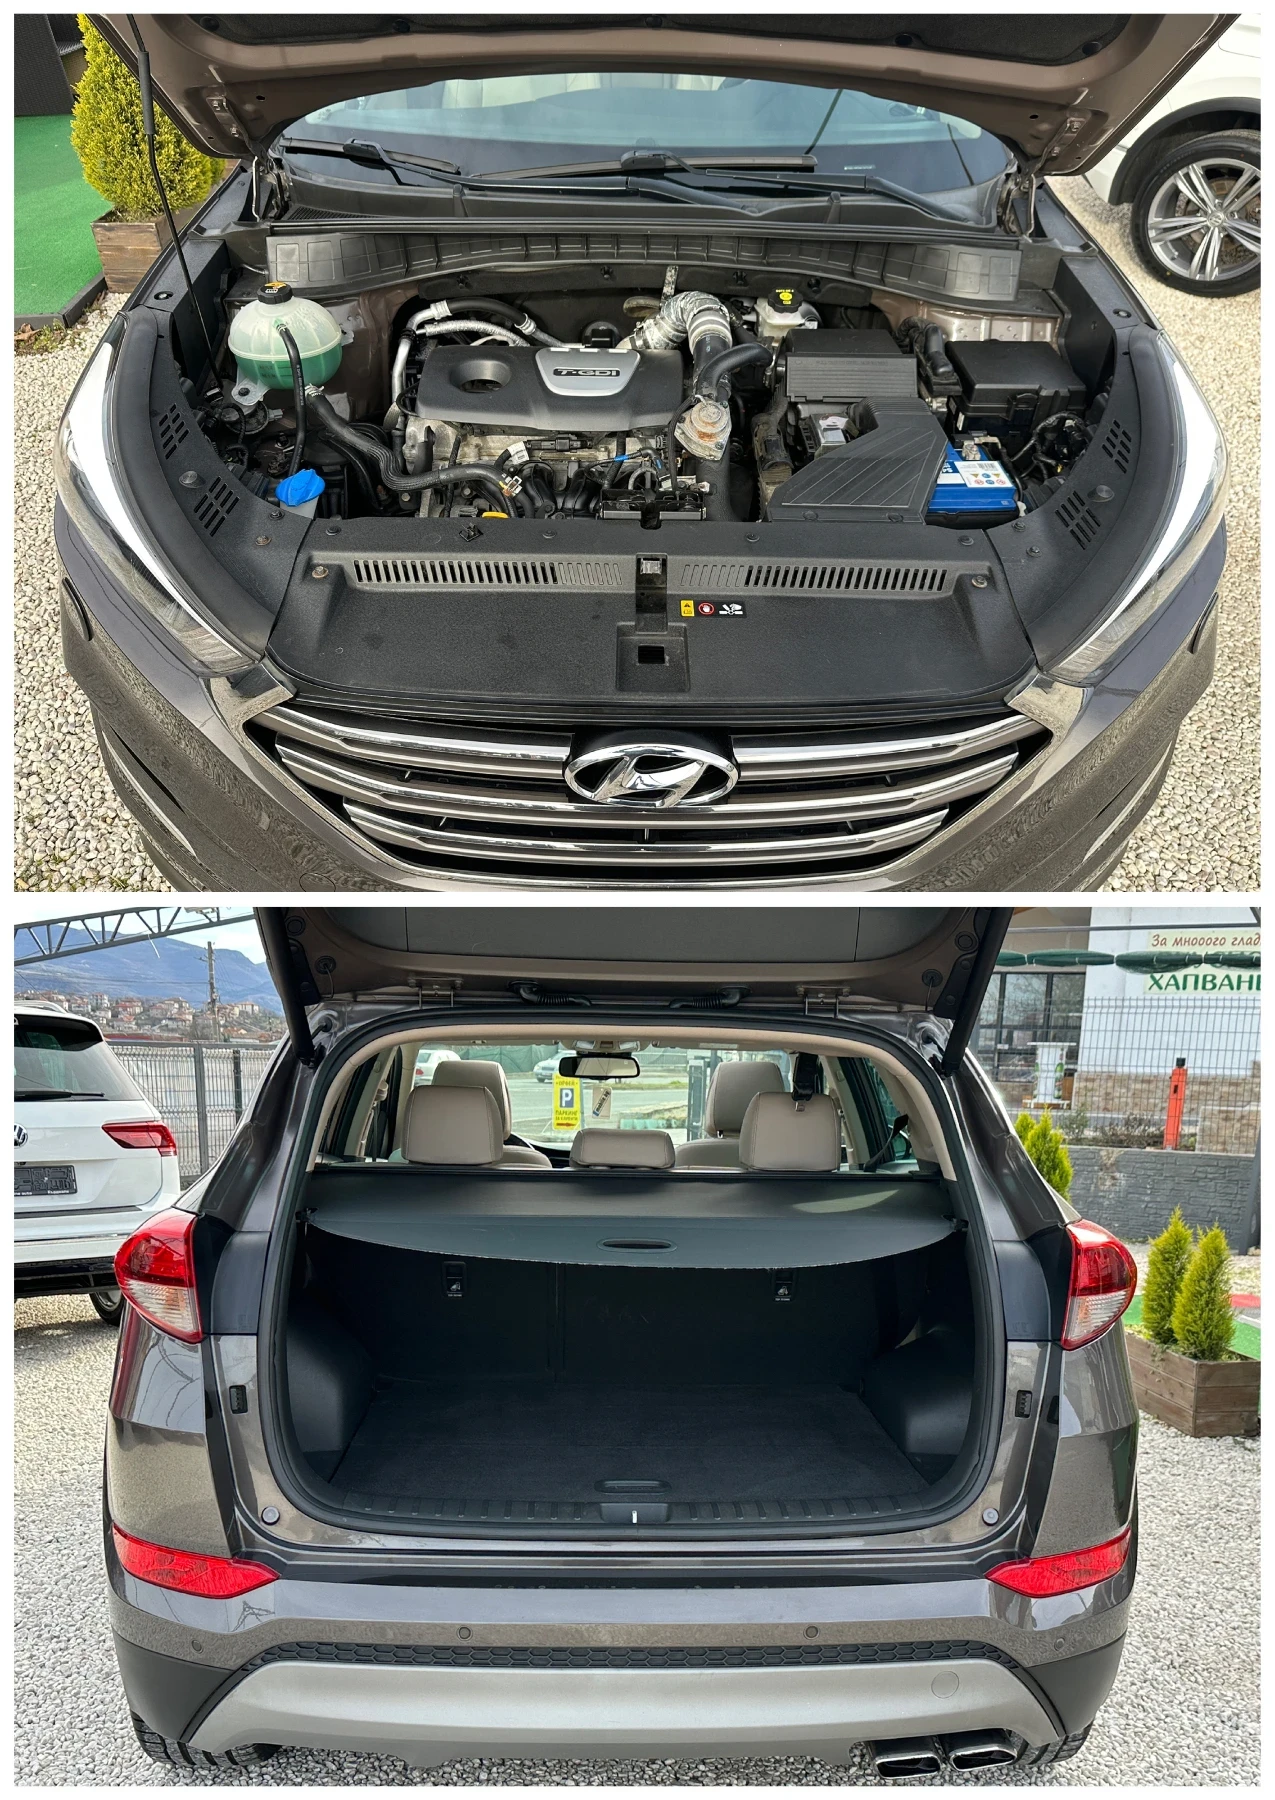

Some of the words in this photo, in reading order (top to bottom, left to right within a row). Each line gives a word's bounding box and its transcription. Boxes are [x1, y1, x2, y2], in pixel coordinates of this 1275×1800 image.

[1151, 934, 1167, 947] За
[1172, 936, 1226, 947] мнооого
[562, 1089, 572, 1107] P
